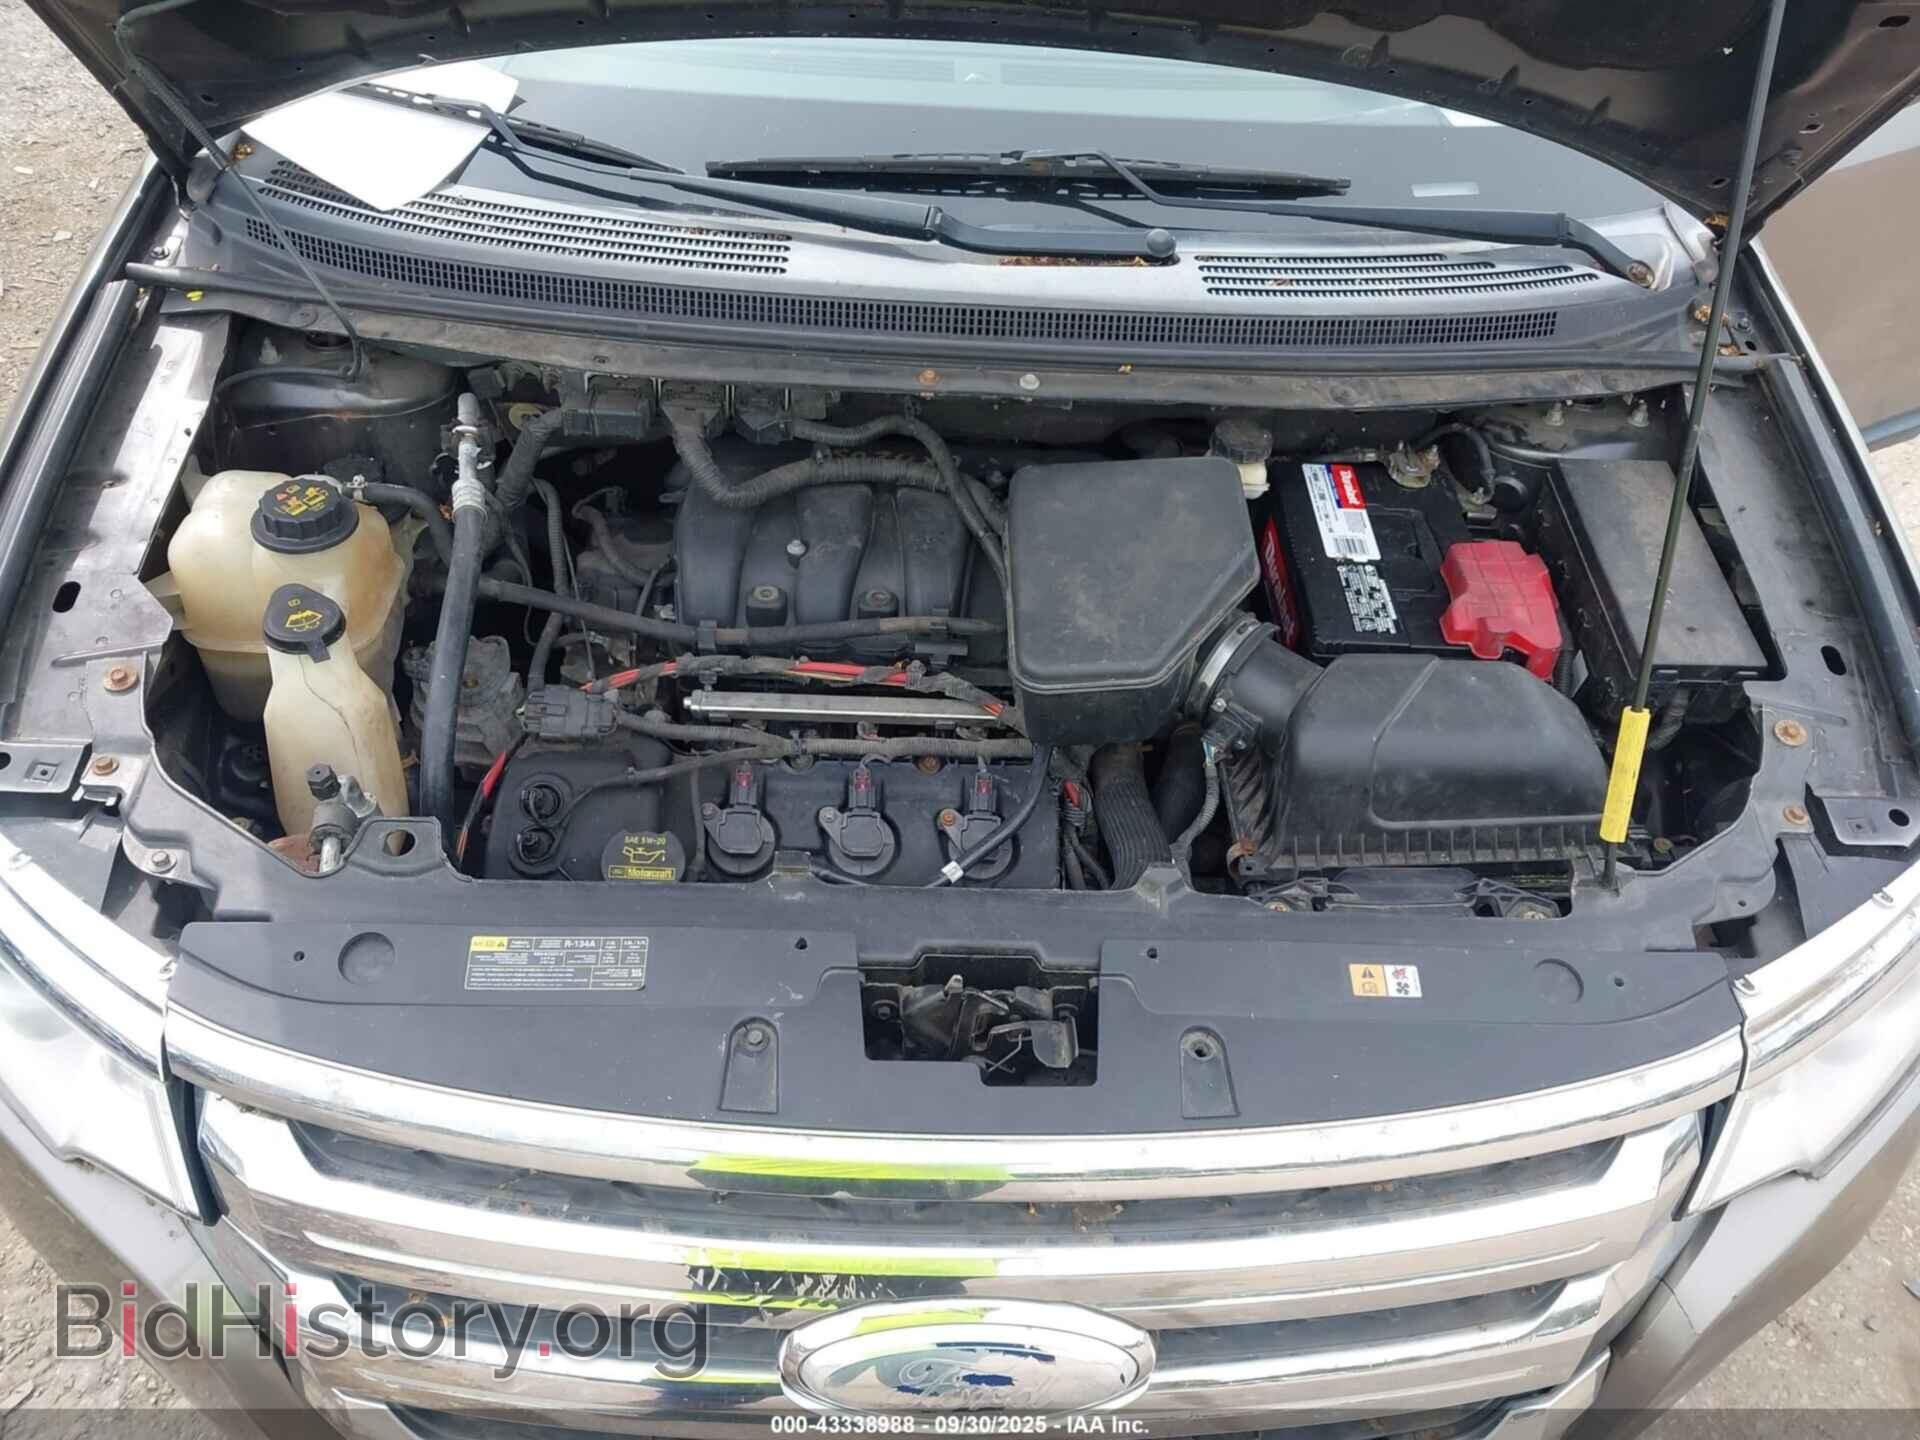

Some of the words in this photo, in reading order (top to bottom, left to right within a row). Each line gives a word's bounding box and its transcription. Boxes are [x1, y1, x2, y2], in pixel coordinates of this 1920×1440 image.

[625, 836, 639, 844] SAE
[627, 868, 673, 880] Motorcraft
[564, 940, 596, 948] R-134A
